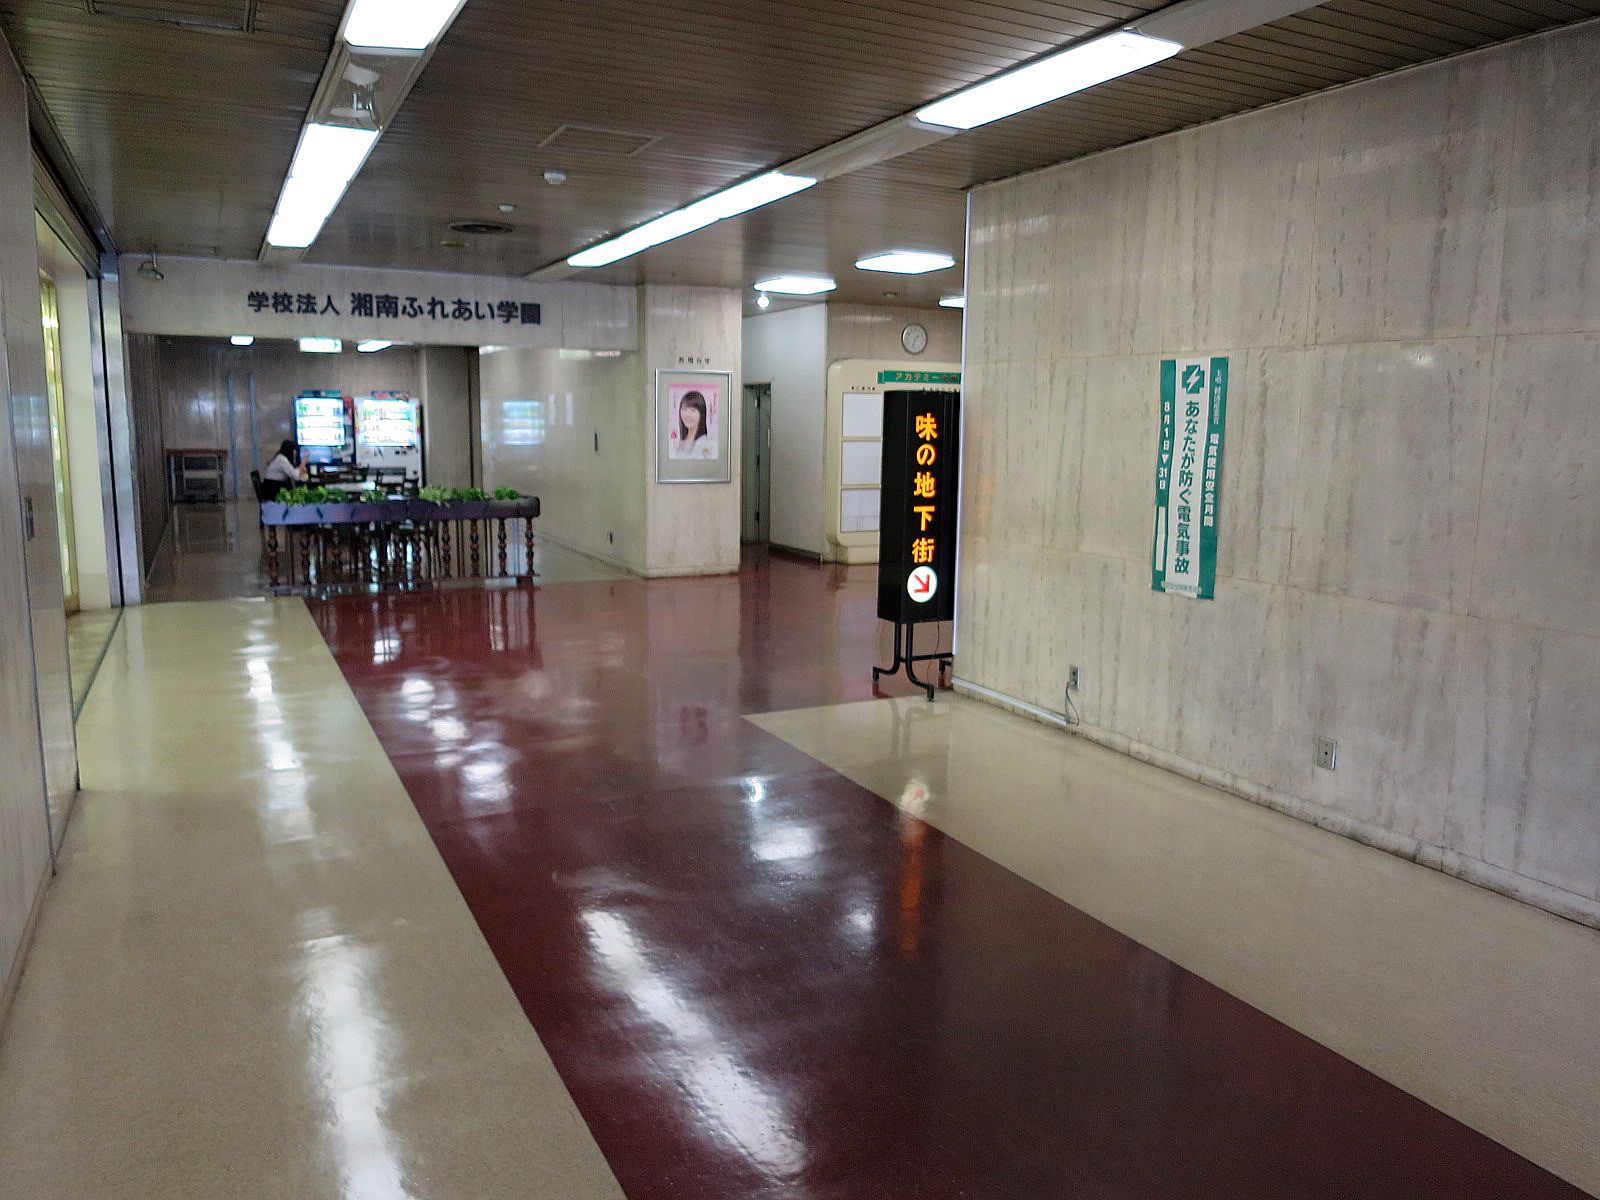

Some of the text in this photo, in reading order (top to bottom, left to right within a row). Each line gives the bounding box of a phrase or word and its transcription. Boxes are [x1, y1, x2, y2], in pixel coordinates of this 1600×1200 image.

[247, 291, 541, 325] 学校法人 湘南ふれあい学園
[911, 413, 938, 563] 味の地下街
[1174, 401, 1200, 575] あなたが防ぐ電気事故
